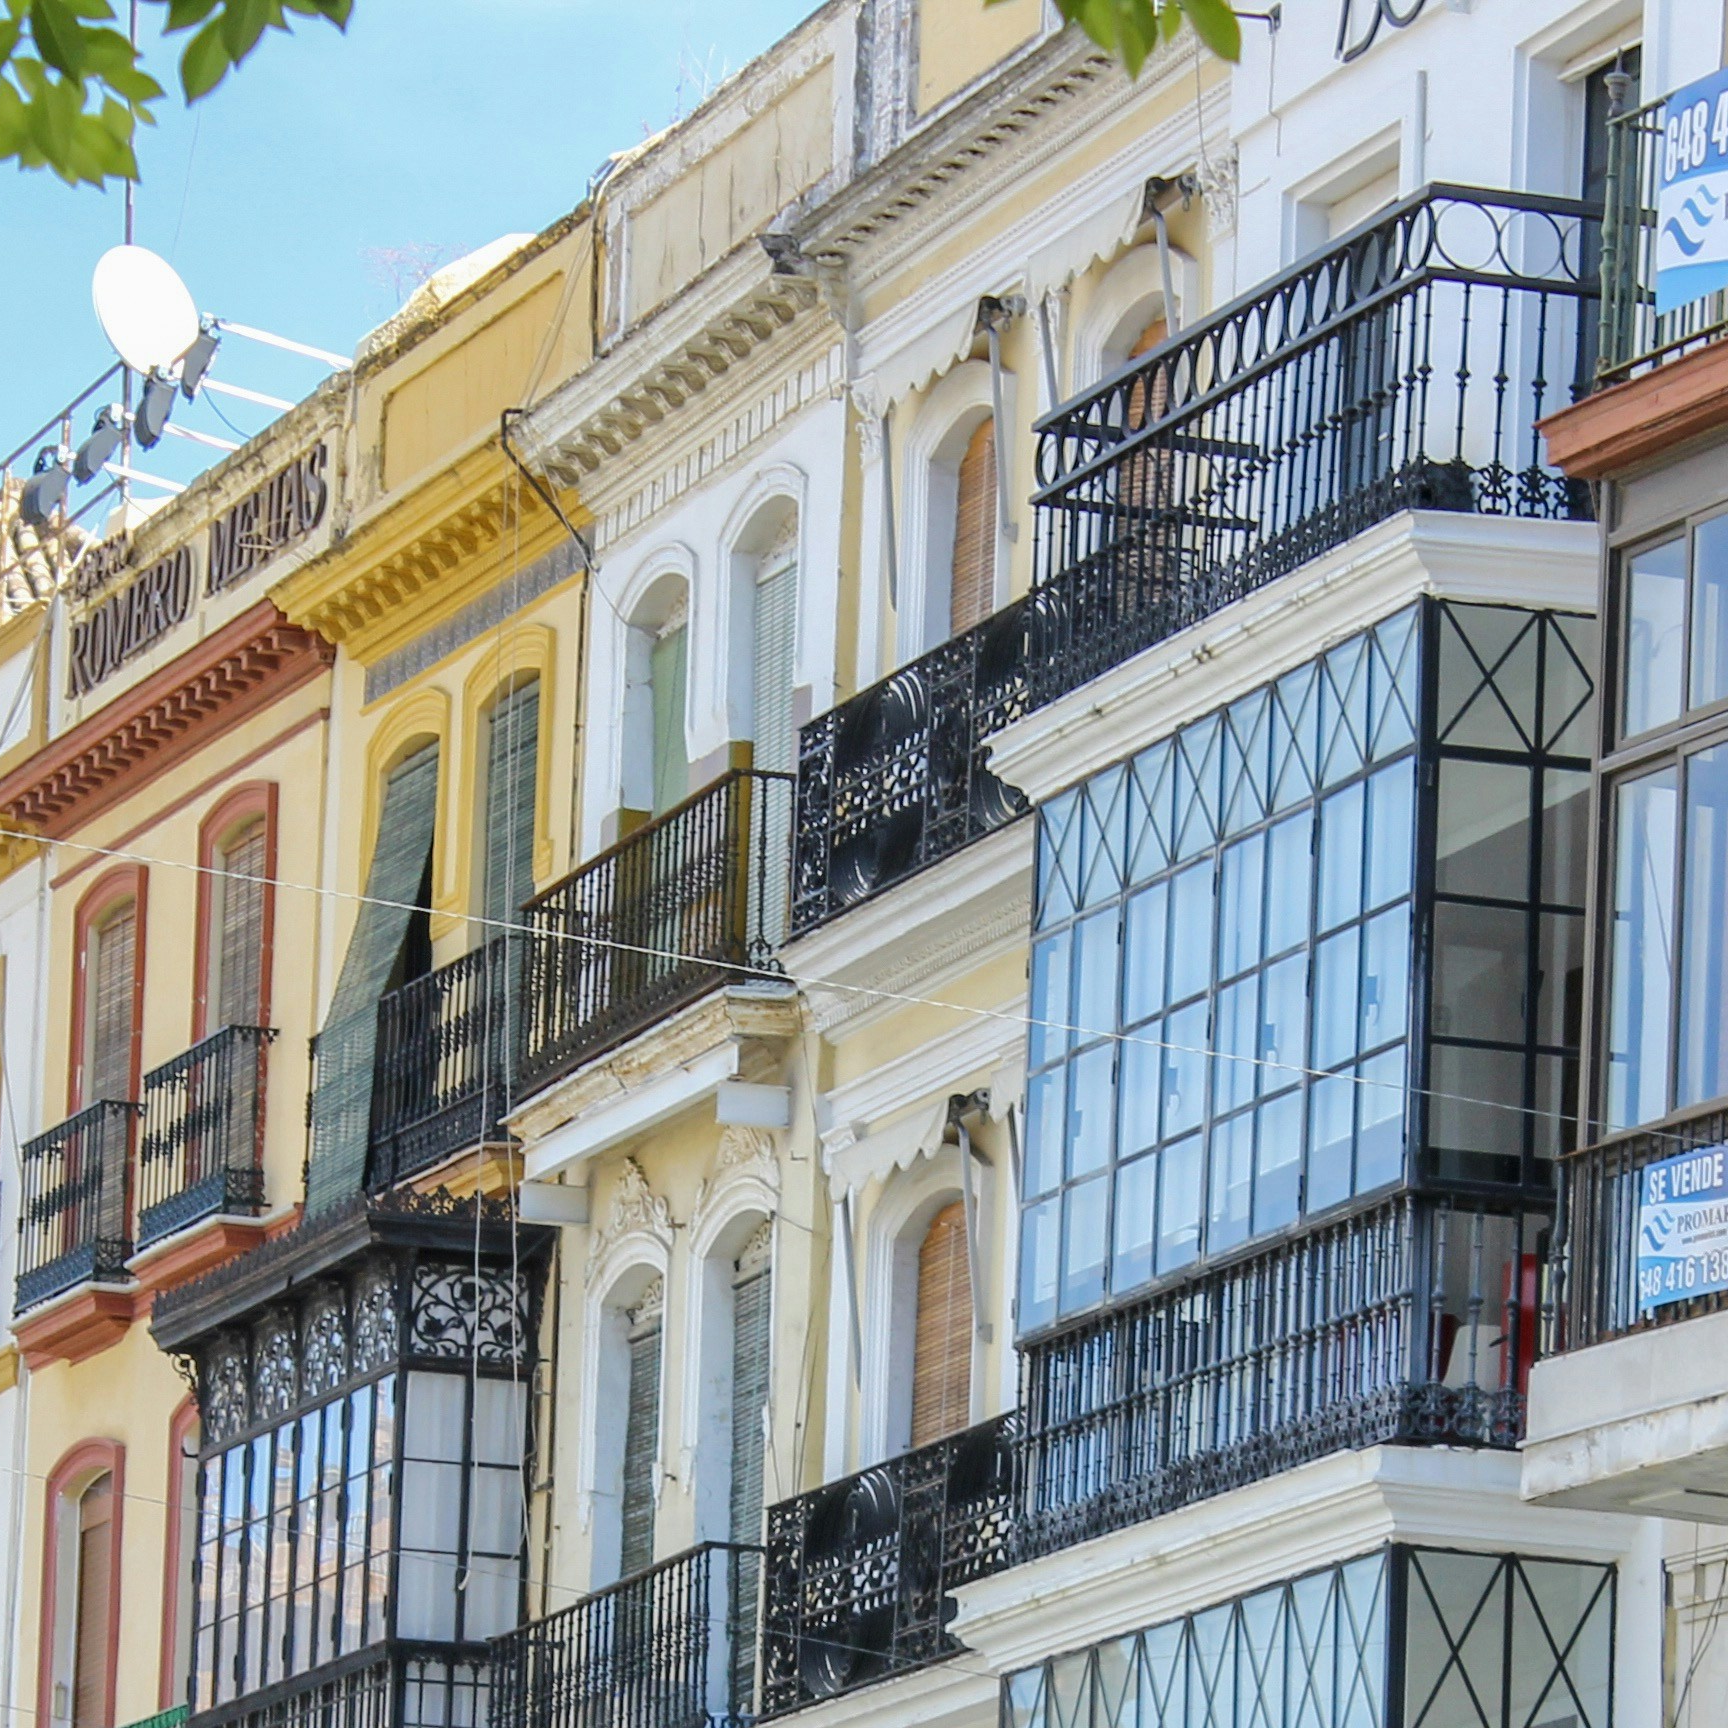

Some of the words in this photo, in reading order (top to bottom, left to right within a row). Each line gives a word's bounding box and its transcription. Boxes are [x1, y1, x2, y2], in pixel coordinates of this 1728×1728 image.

[1664, 100, 1709, 182] 648
[65, 546, 191, 700] ROMERO
[1649, 1168, 1667, 1205] SE
[1672, 1153, 1724, 1198] VENDE
[1665, 1257, 1695, 1291] 416
